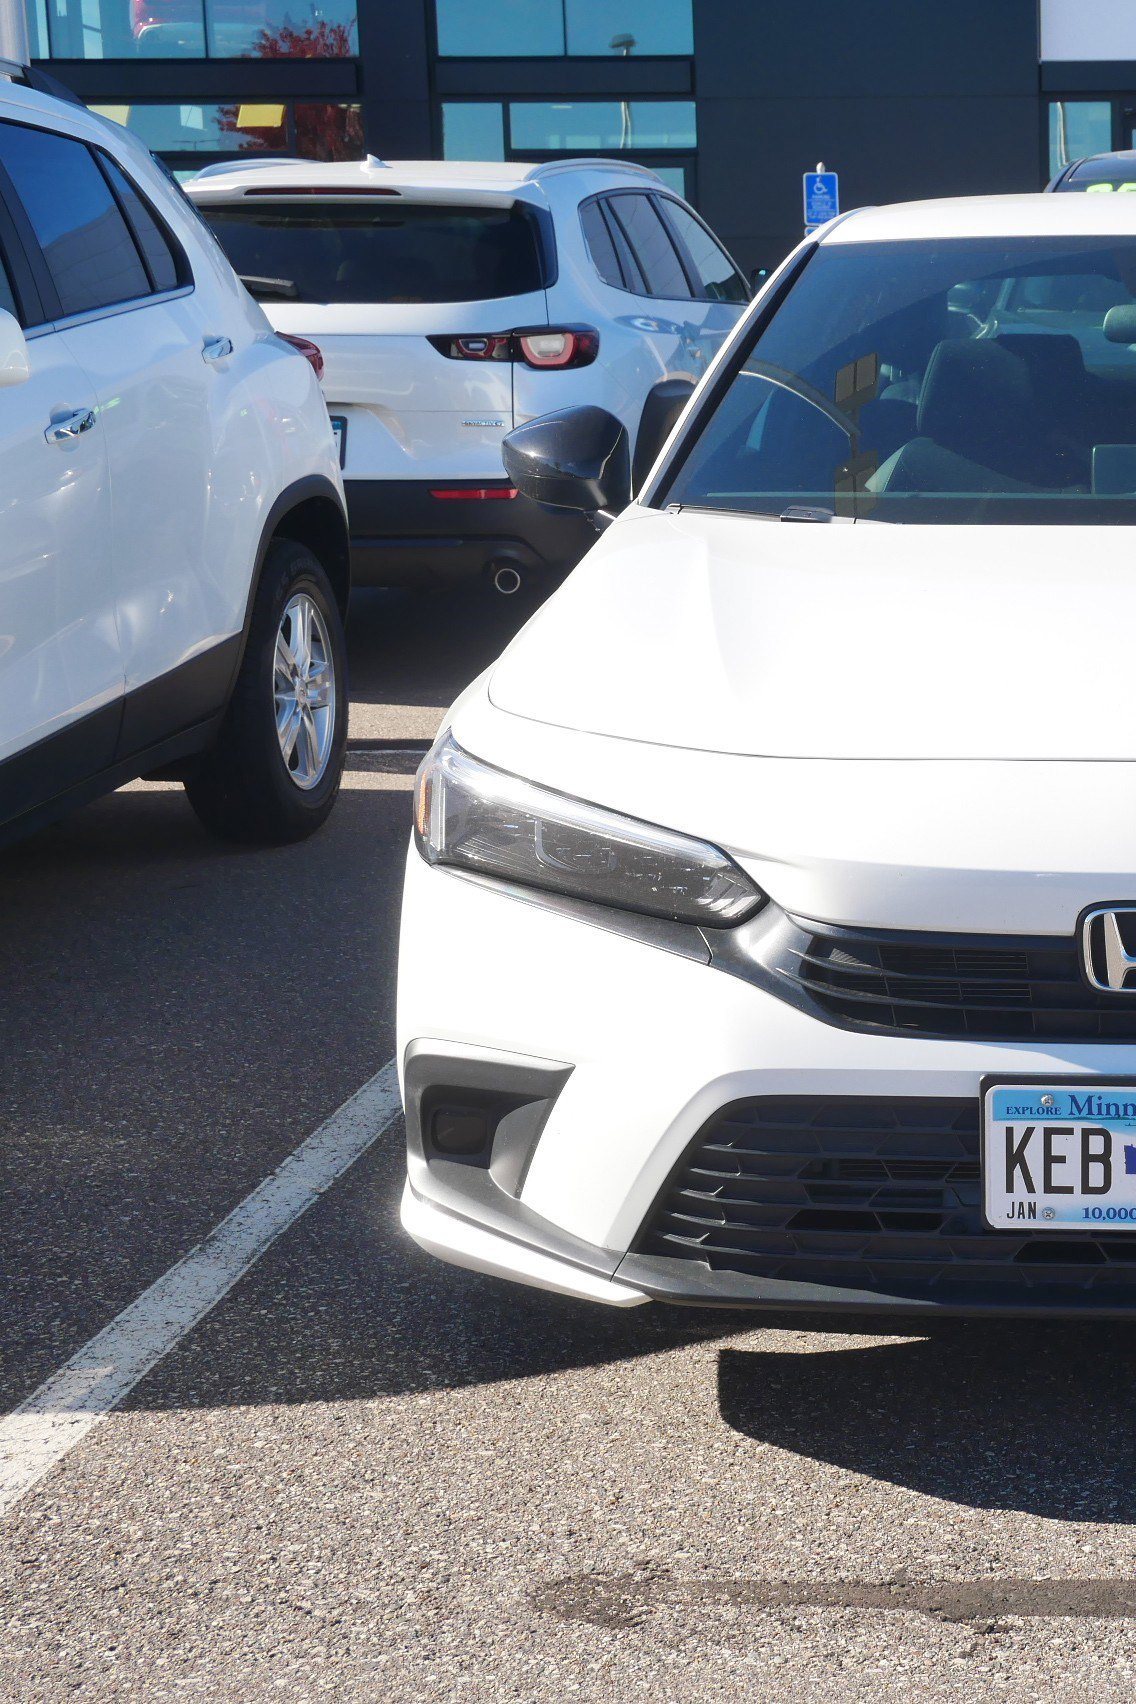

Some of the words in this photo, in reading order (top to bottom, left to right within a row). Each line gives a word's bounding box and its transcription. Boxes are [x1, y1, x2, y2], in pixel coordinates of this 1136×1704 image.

[1005, 1105, 1062, 1116] EXPLORE
[1004, 1126, 1113, 1195] KEB
[1006, 1201, 1037, 1220] JAN
